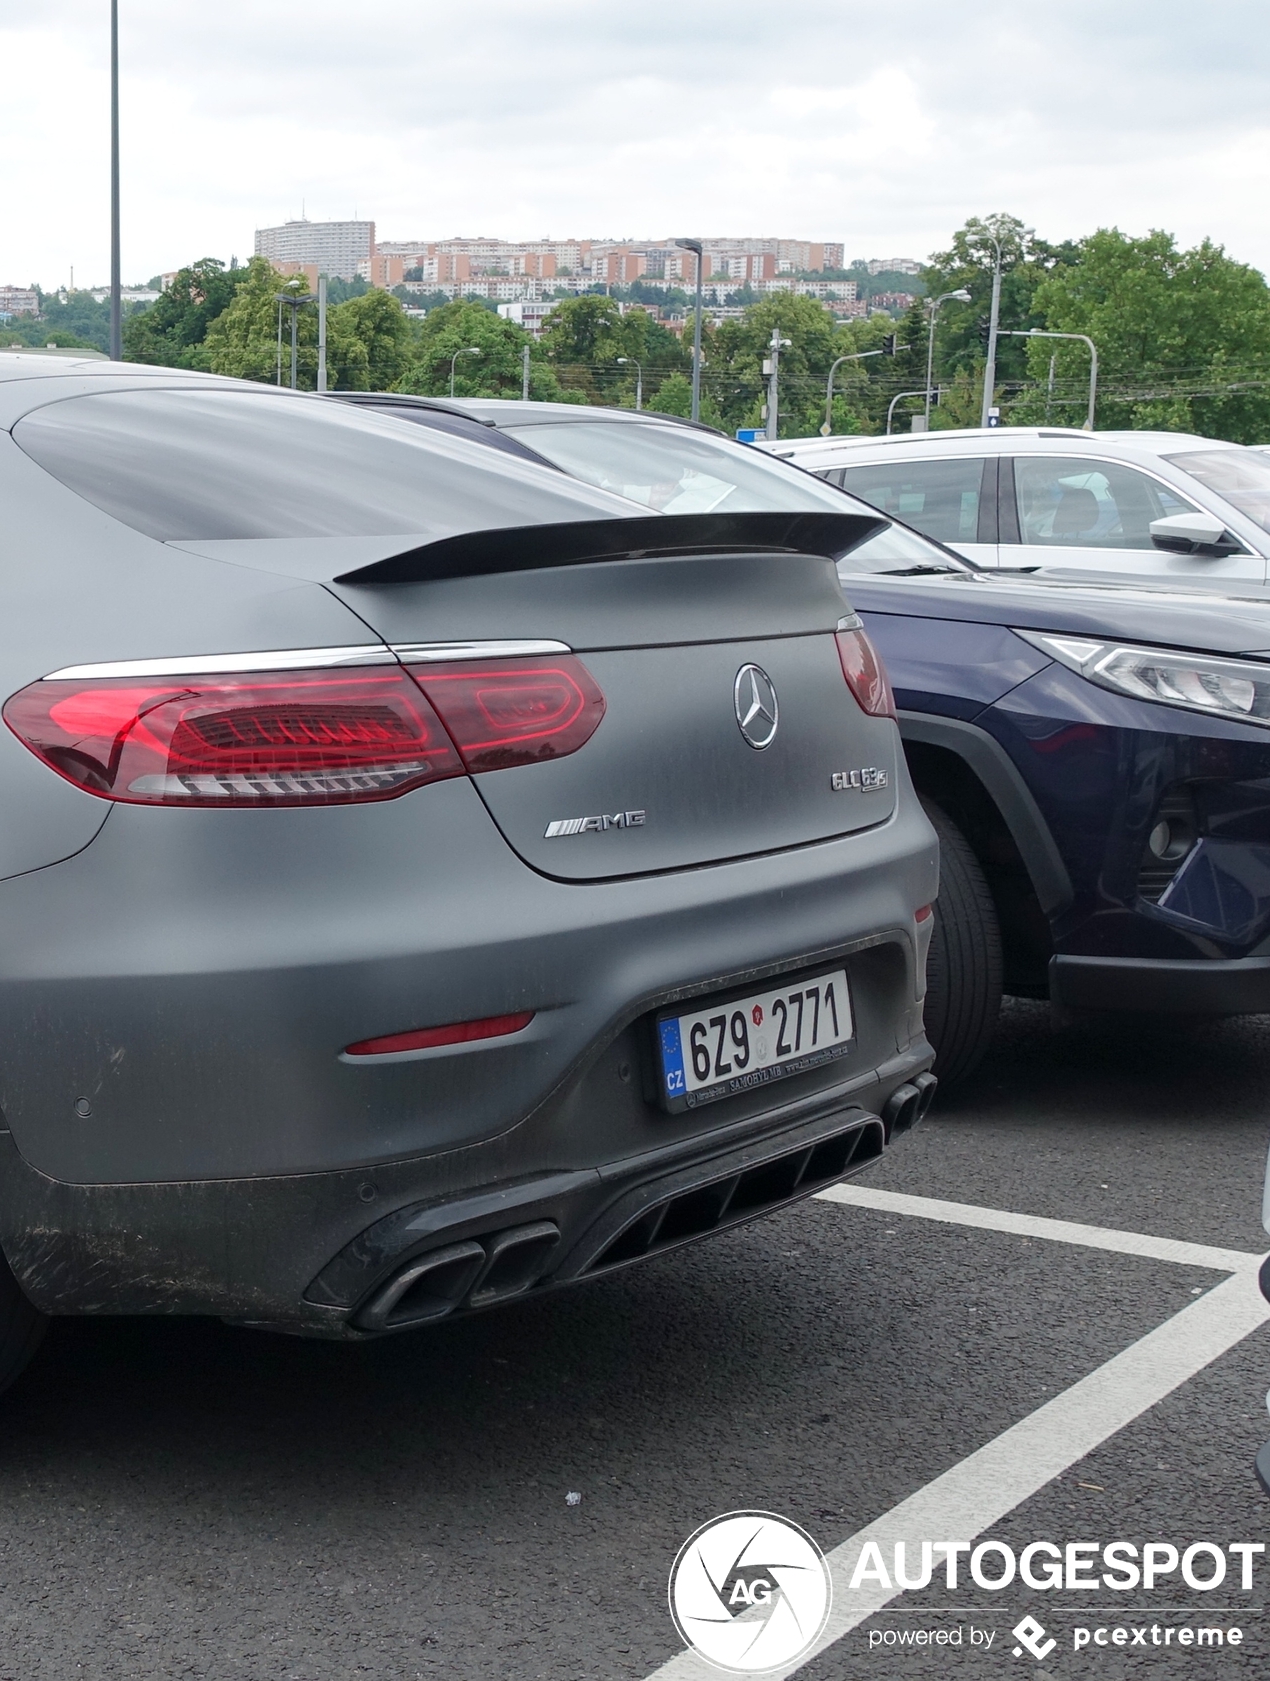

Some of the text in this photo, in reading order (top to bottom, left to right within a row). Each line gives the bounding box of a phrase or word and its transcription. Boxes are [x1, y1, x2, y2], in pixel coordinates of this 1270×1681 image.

[579, 810, 646, 833] AMG
[690, 982, 839, 1082] 6Z9 2771
[667, 1070, 683, 1091] CZ
